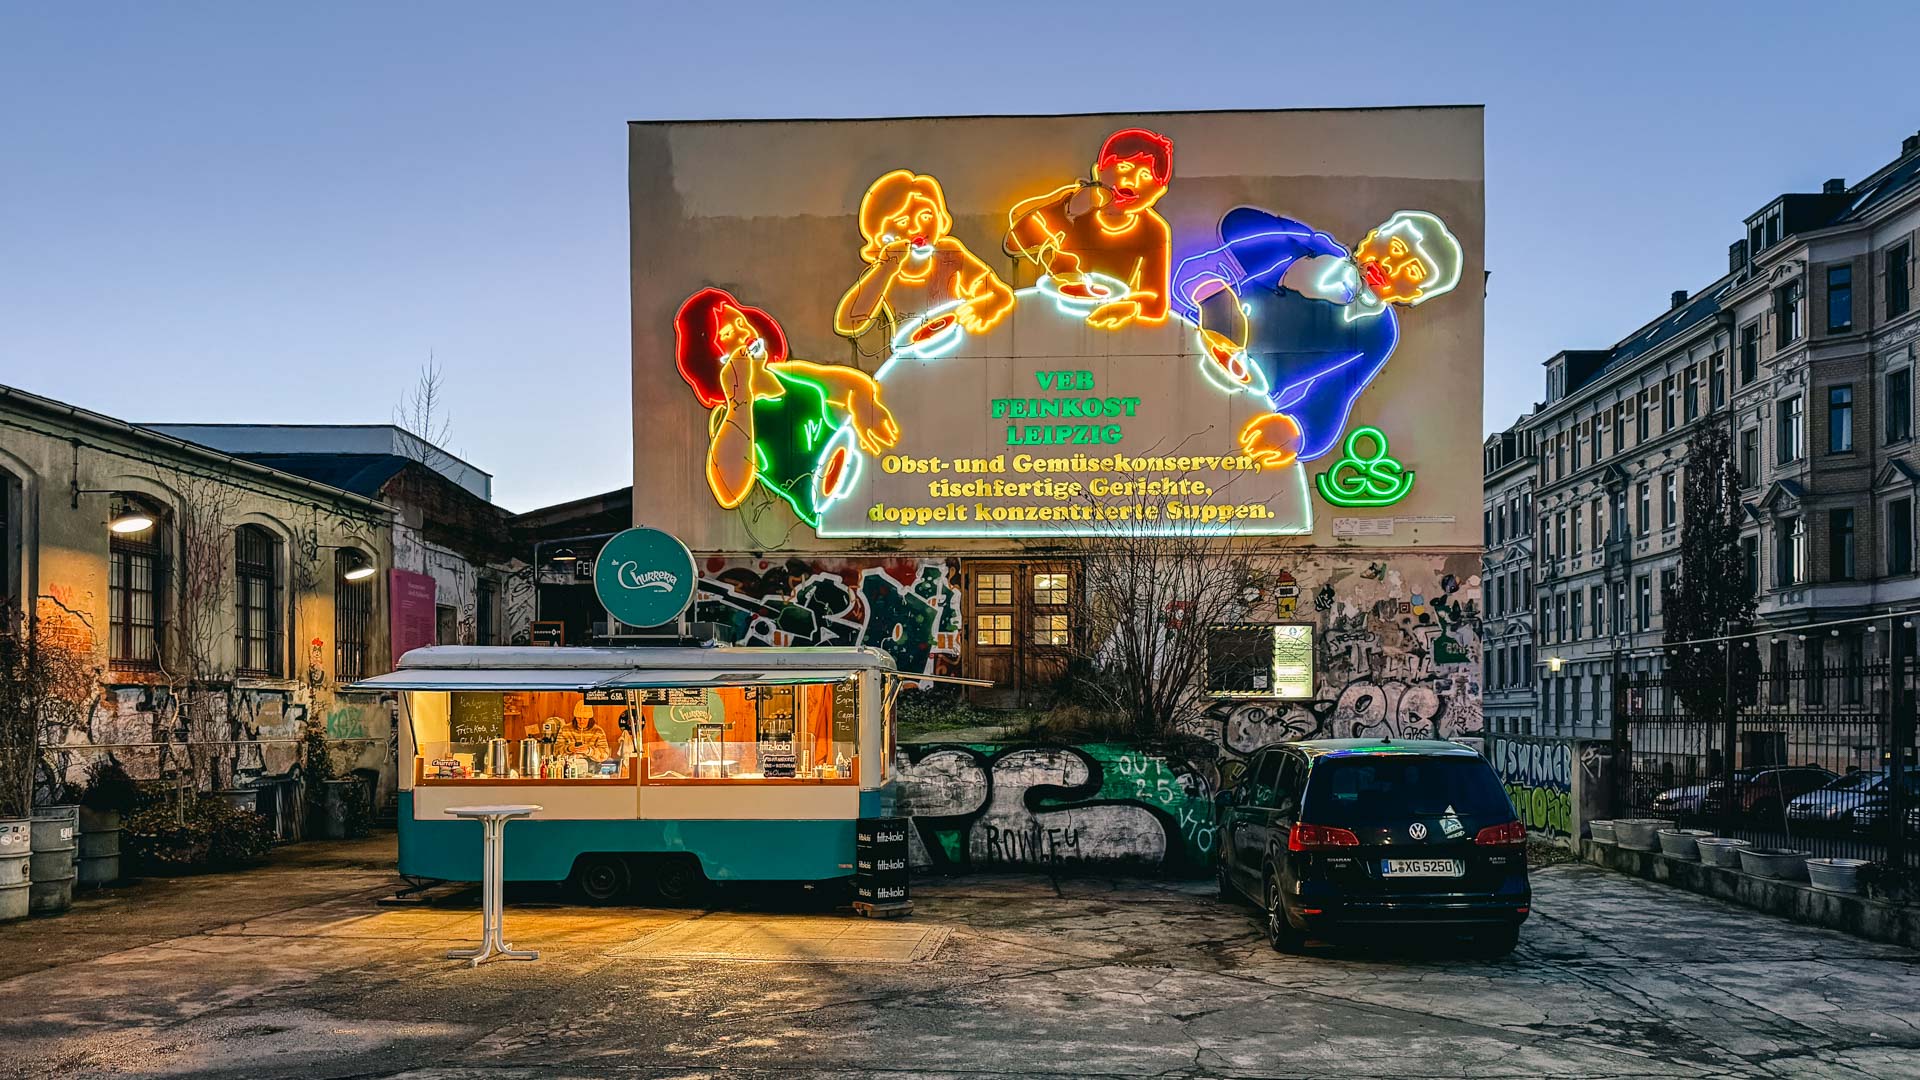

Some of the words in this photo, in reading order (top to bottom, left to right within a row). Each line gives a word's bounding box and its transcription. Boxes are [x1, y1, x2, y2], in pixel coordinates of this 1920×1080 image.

[1034, 370, 1095, 391] VEB
[991, 397, 1141, 419] FEINKOST
[1005, 424, 1124, 446] LEIPZIG
[881, 454, 950, 474] Obst-
[953, 454, 1006, 473] und
[1012, 453, 1263, 474] Gemüsekonserven,
[928, 478, 1083, 500] tischfertige
[1089, 477, 1214, 497] Gerichte,
[868, 503, 968, 526] doppelt
[974, 502, 1160, 522] konzentrierte
[1166, 501, 1275, 524] Suppen.
[1119, 756, 1167, 775] OUT
[1136, 779, 1173, 804] 25
[876, 831, 904, 843] fritz-kola
[877, 859, 905, 871] fritz-kola
[1389, 861, 1399, 873] L
[1405, 862, 1421, 873] XG
[1424, 861, 1452, 873] 5250
[877, 887, 905, 899] fritz-kola
